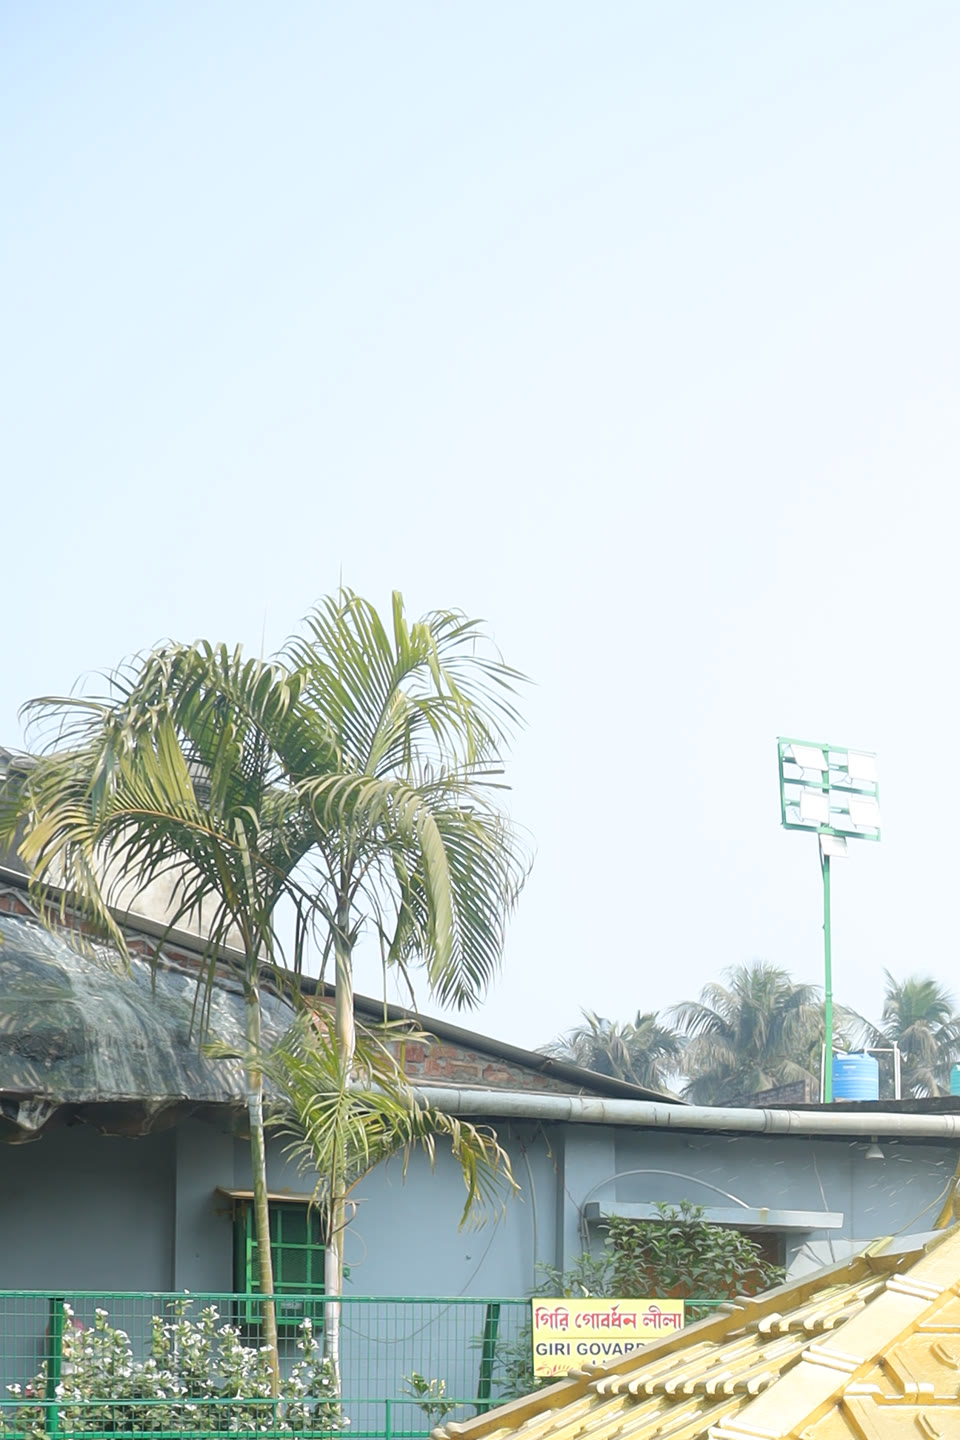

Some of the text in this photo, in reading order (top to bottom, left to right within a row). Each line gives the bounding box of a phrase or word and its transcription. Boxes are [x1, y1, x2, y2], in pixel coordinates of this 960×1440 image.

[535, 1304, 682, 1331] গিরি গোবর্ধন লীলা
[536, 1342, 570, 1356] GIRI
